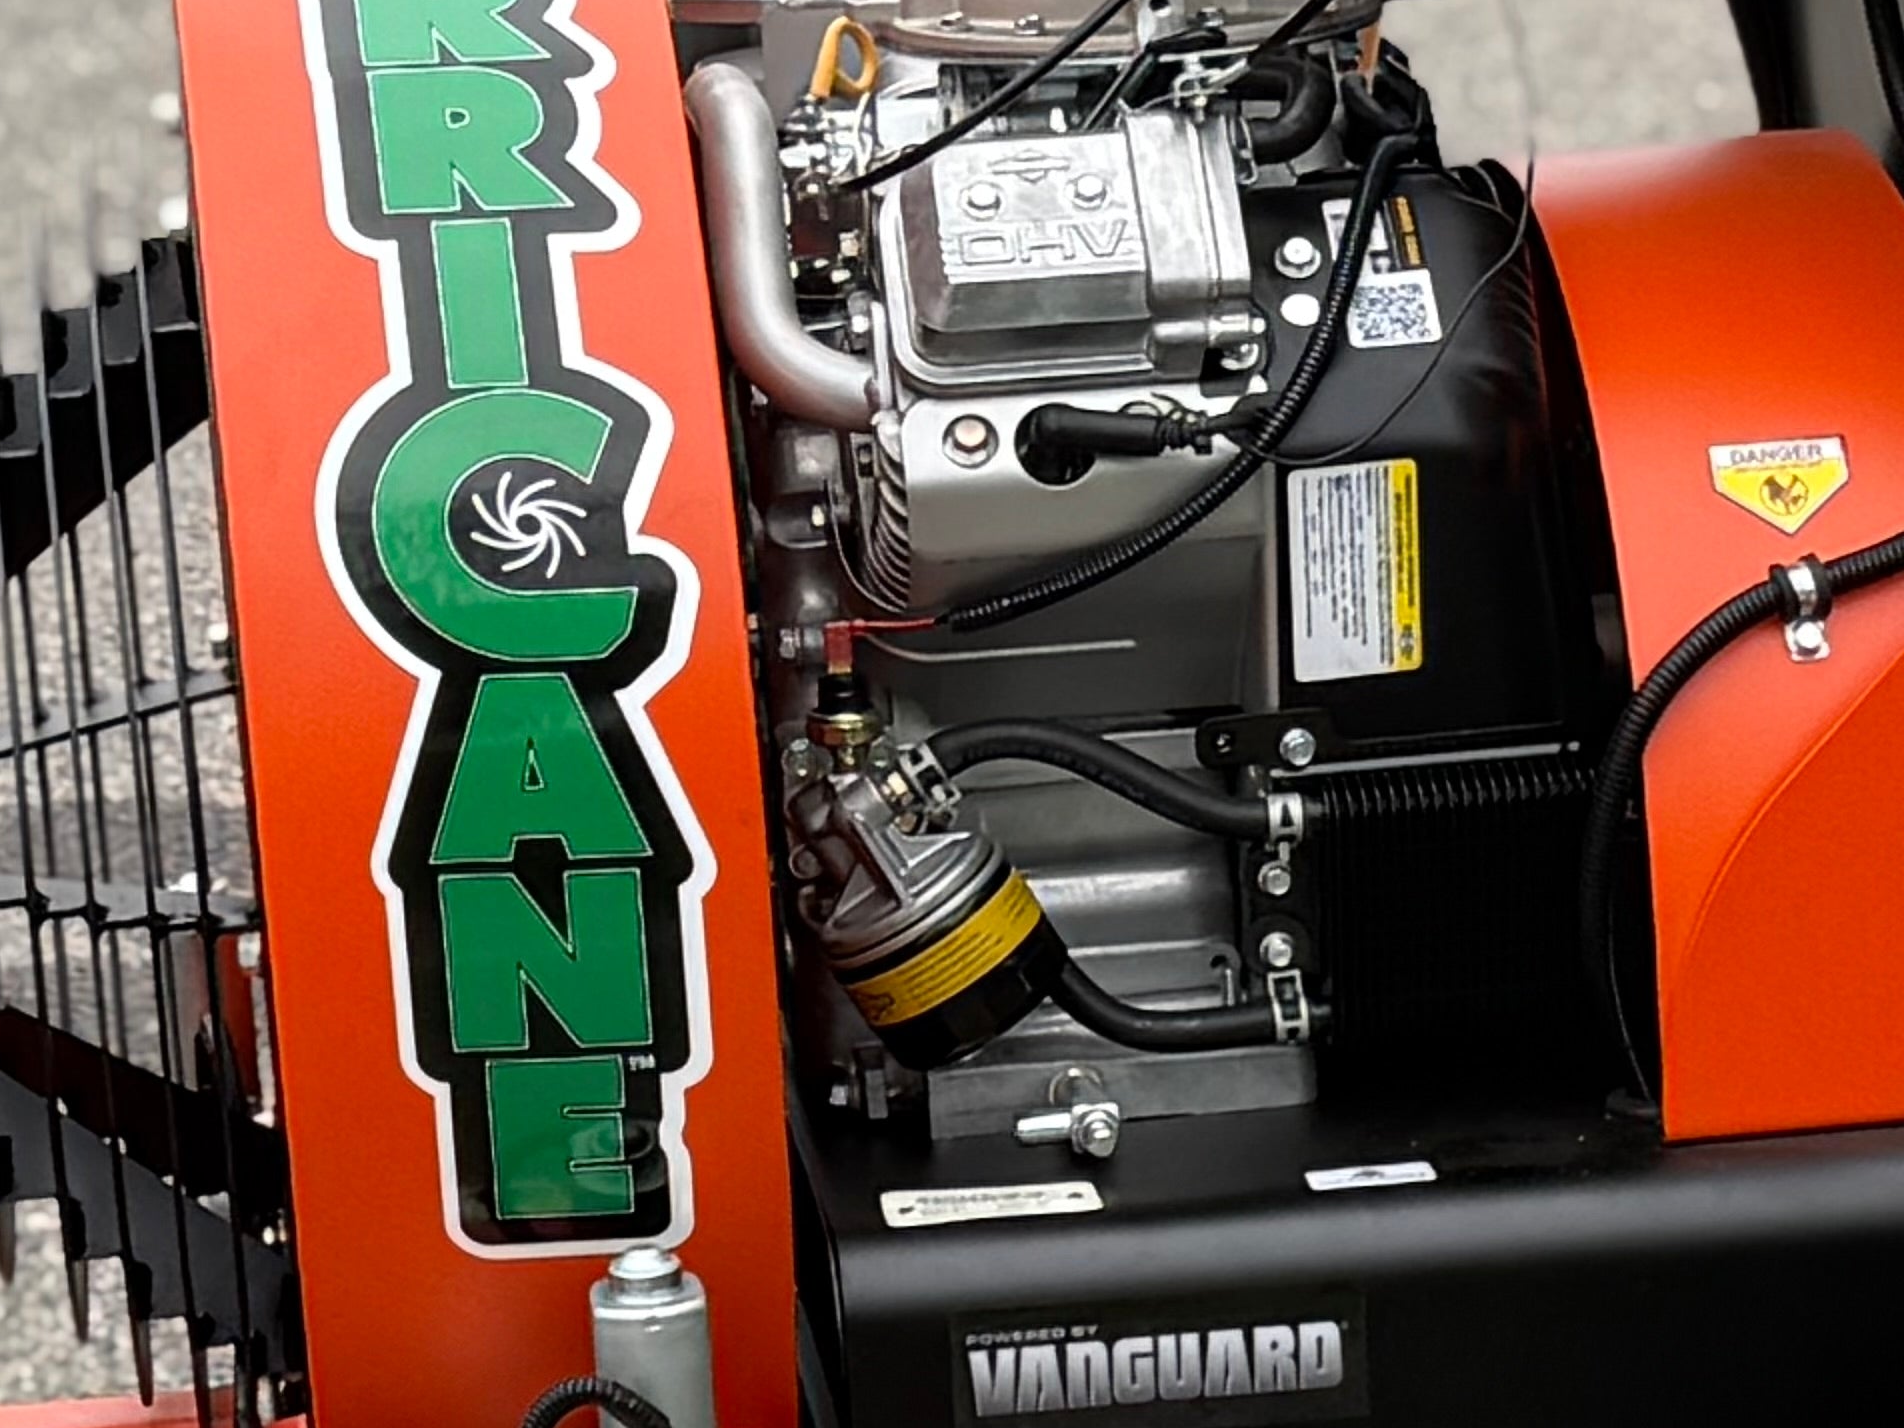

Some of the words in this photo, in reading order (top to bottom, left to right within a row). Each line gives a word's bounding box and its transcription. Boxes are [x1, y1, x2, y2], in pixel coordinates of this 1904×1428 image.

[961, 217, 1129, 267] OHV
[1729, 443, 1823, 467] DANGER
[964, 1327, 1066, 1347] POWERED
[1072, 1324, 1099, 1338] BY
[967, 1320, 1345, 1418] VANGUARD
